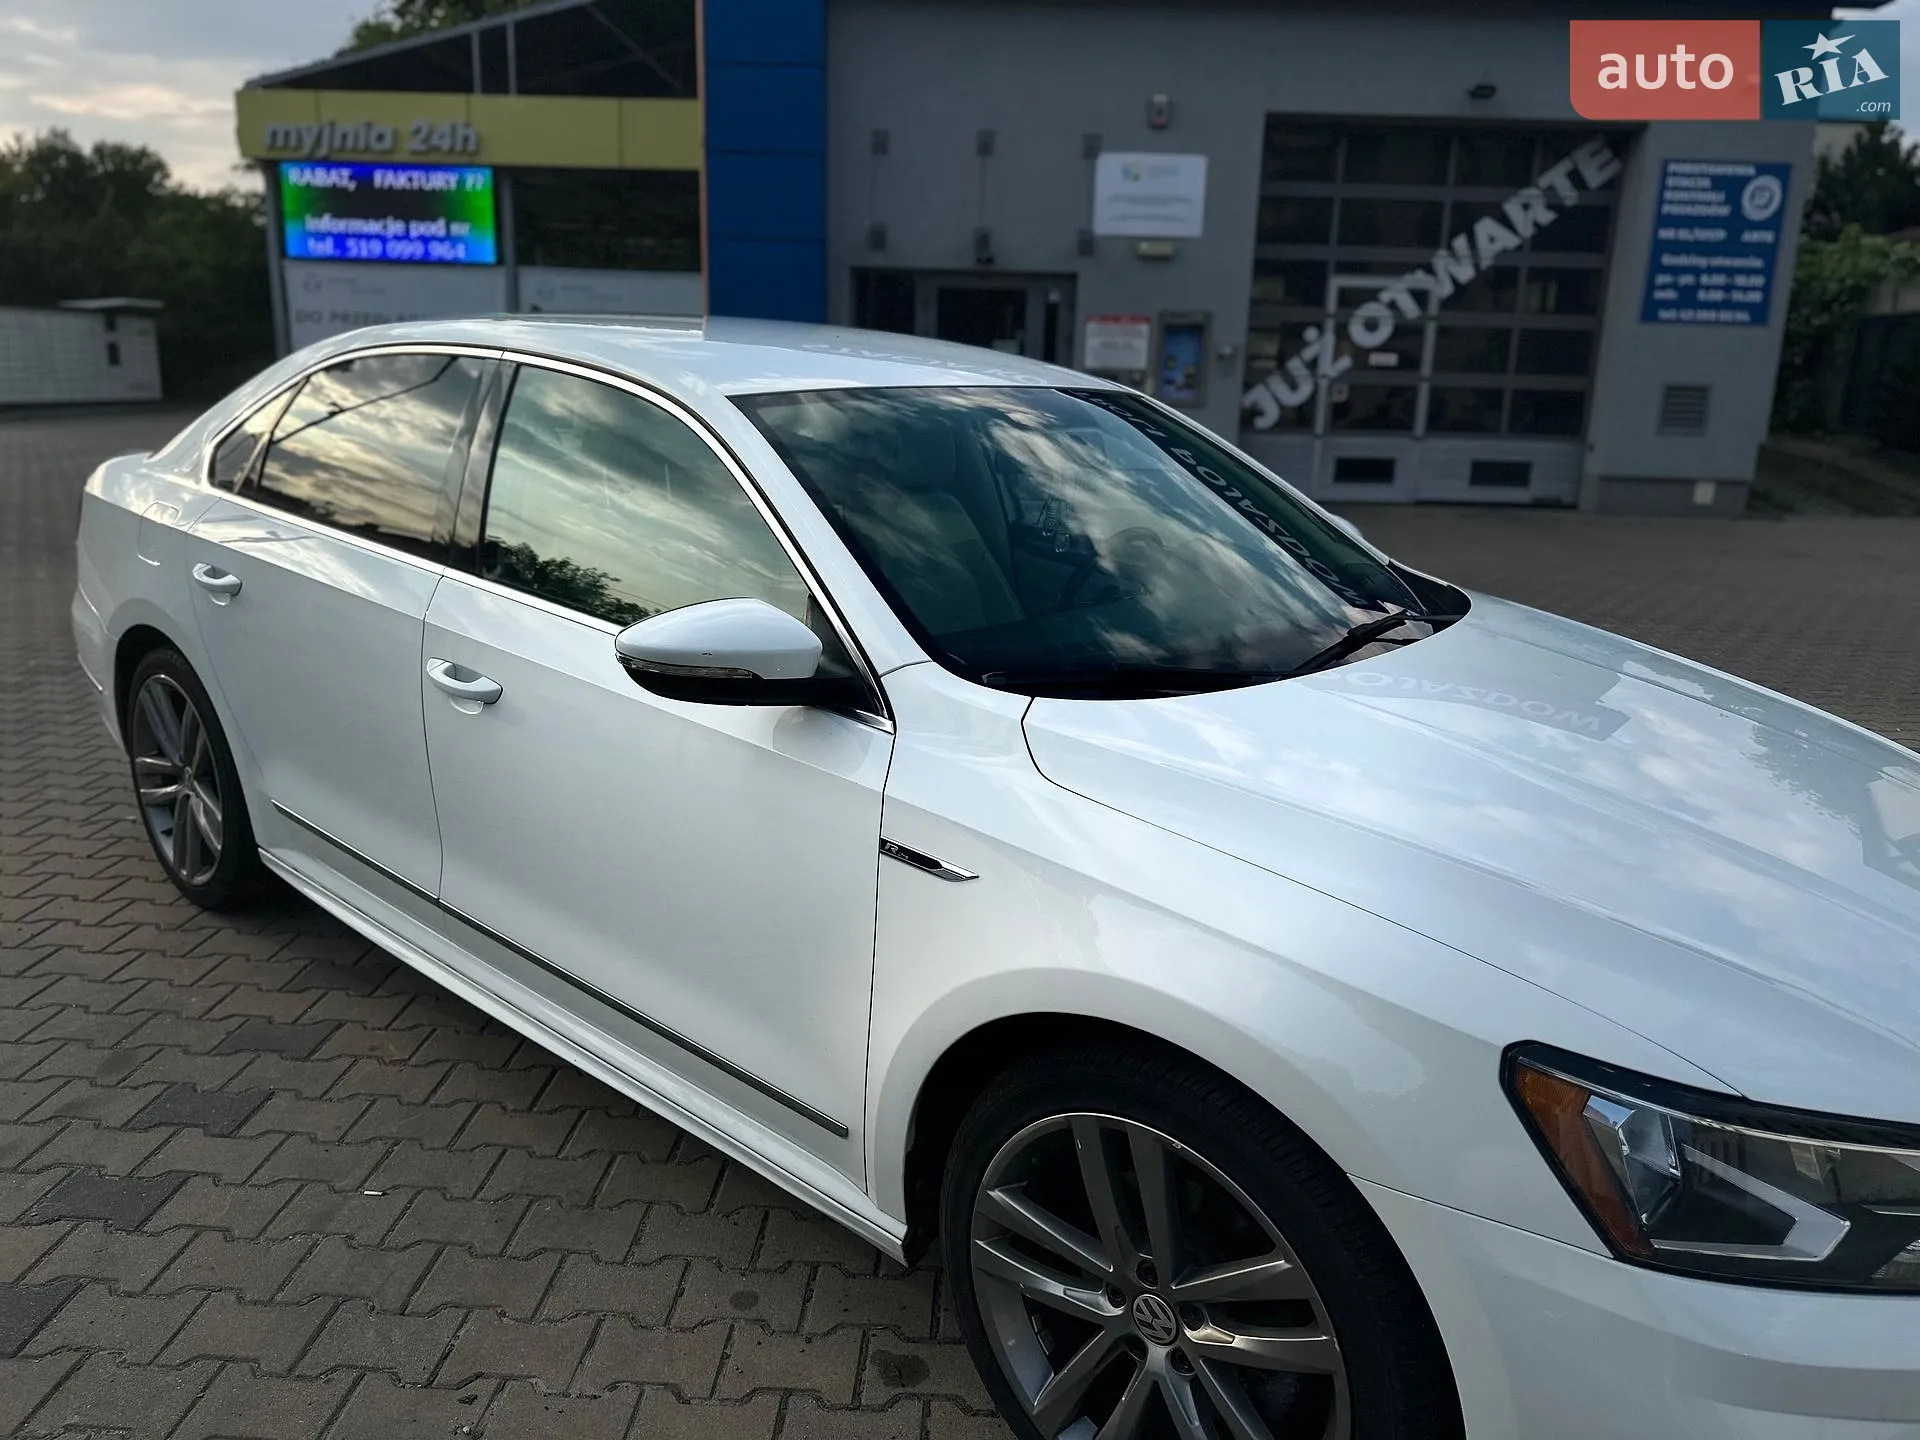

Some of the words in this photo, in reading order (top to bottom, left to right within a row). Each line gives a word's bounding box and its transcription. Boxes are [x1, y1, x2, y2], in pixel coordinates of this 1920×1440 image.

[265, 121, 394, 159] myjnia
[409, 119, 477, 153] 24h
[1347, 136, 1623, 348] OTWARTE
